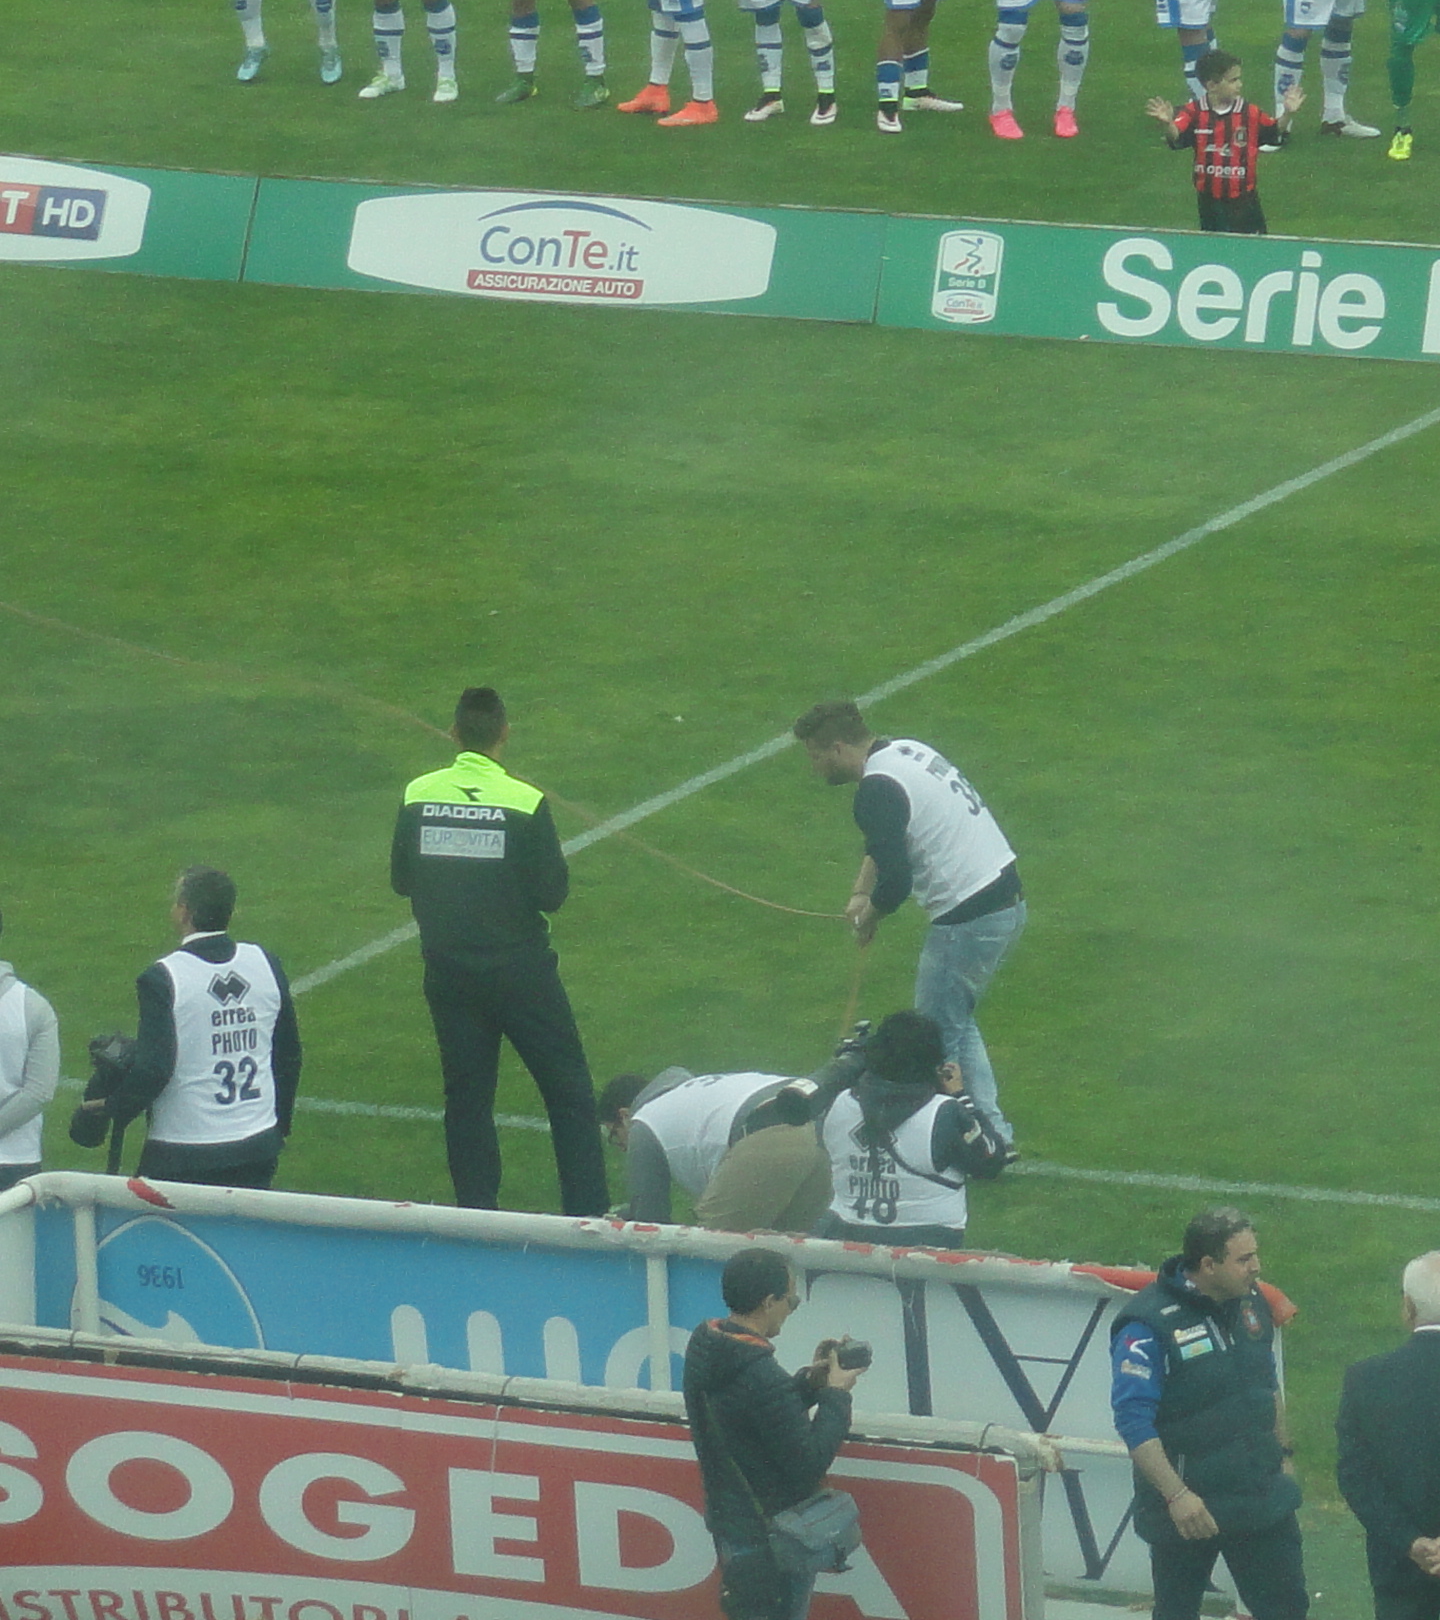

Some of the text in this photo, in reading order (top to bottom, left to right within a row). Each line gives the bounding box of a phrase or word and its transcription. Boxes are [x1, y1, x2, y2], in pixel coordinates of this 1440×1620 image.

[1207, 163, 1246, 179] opera
[42, 196, 96, 229] HD
[480, 225, 640, 272] ConTe.it
[473, 272, 636, 297] ASSICURAZIONE AUTO
[1096, 236, 1387, 351] Serie
[422, 803, 507, 822] DIADORA
[211, 1028, 258, 1056] PHOTO
[213, 1055, 262, 1106] 32
